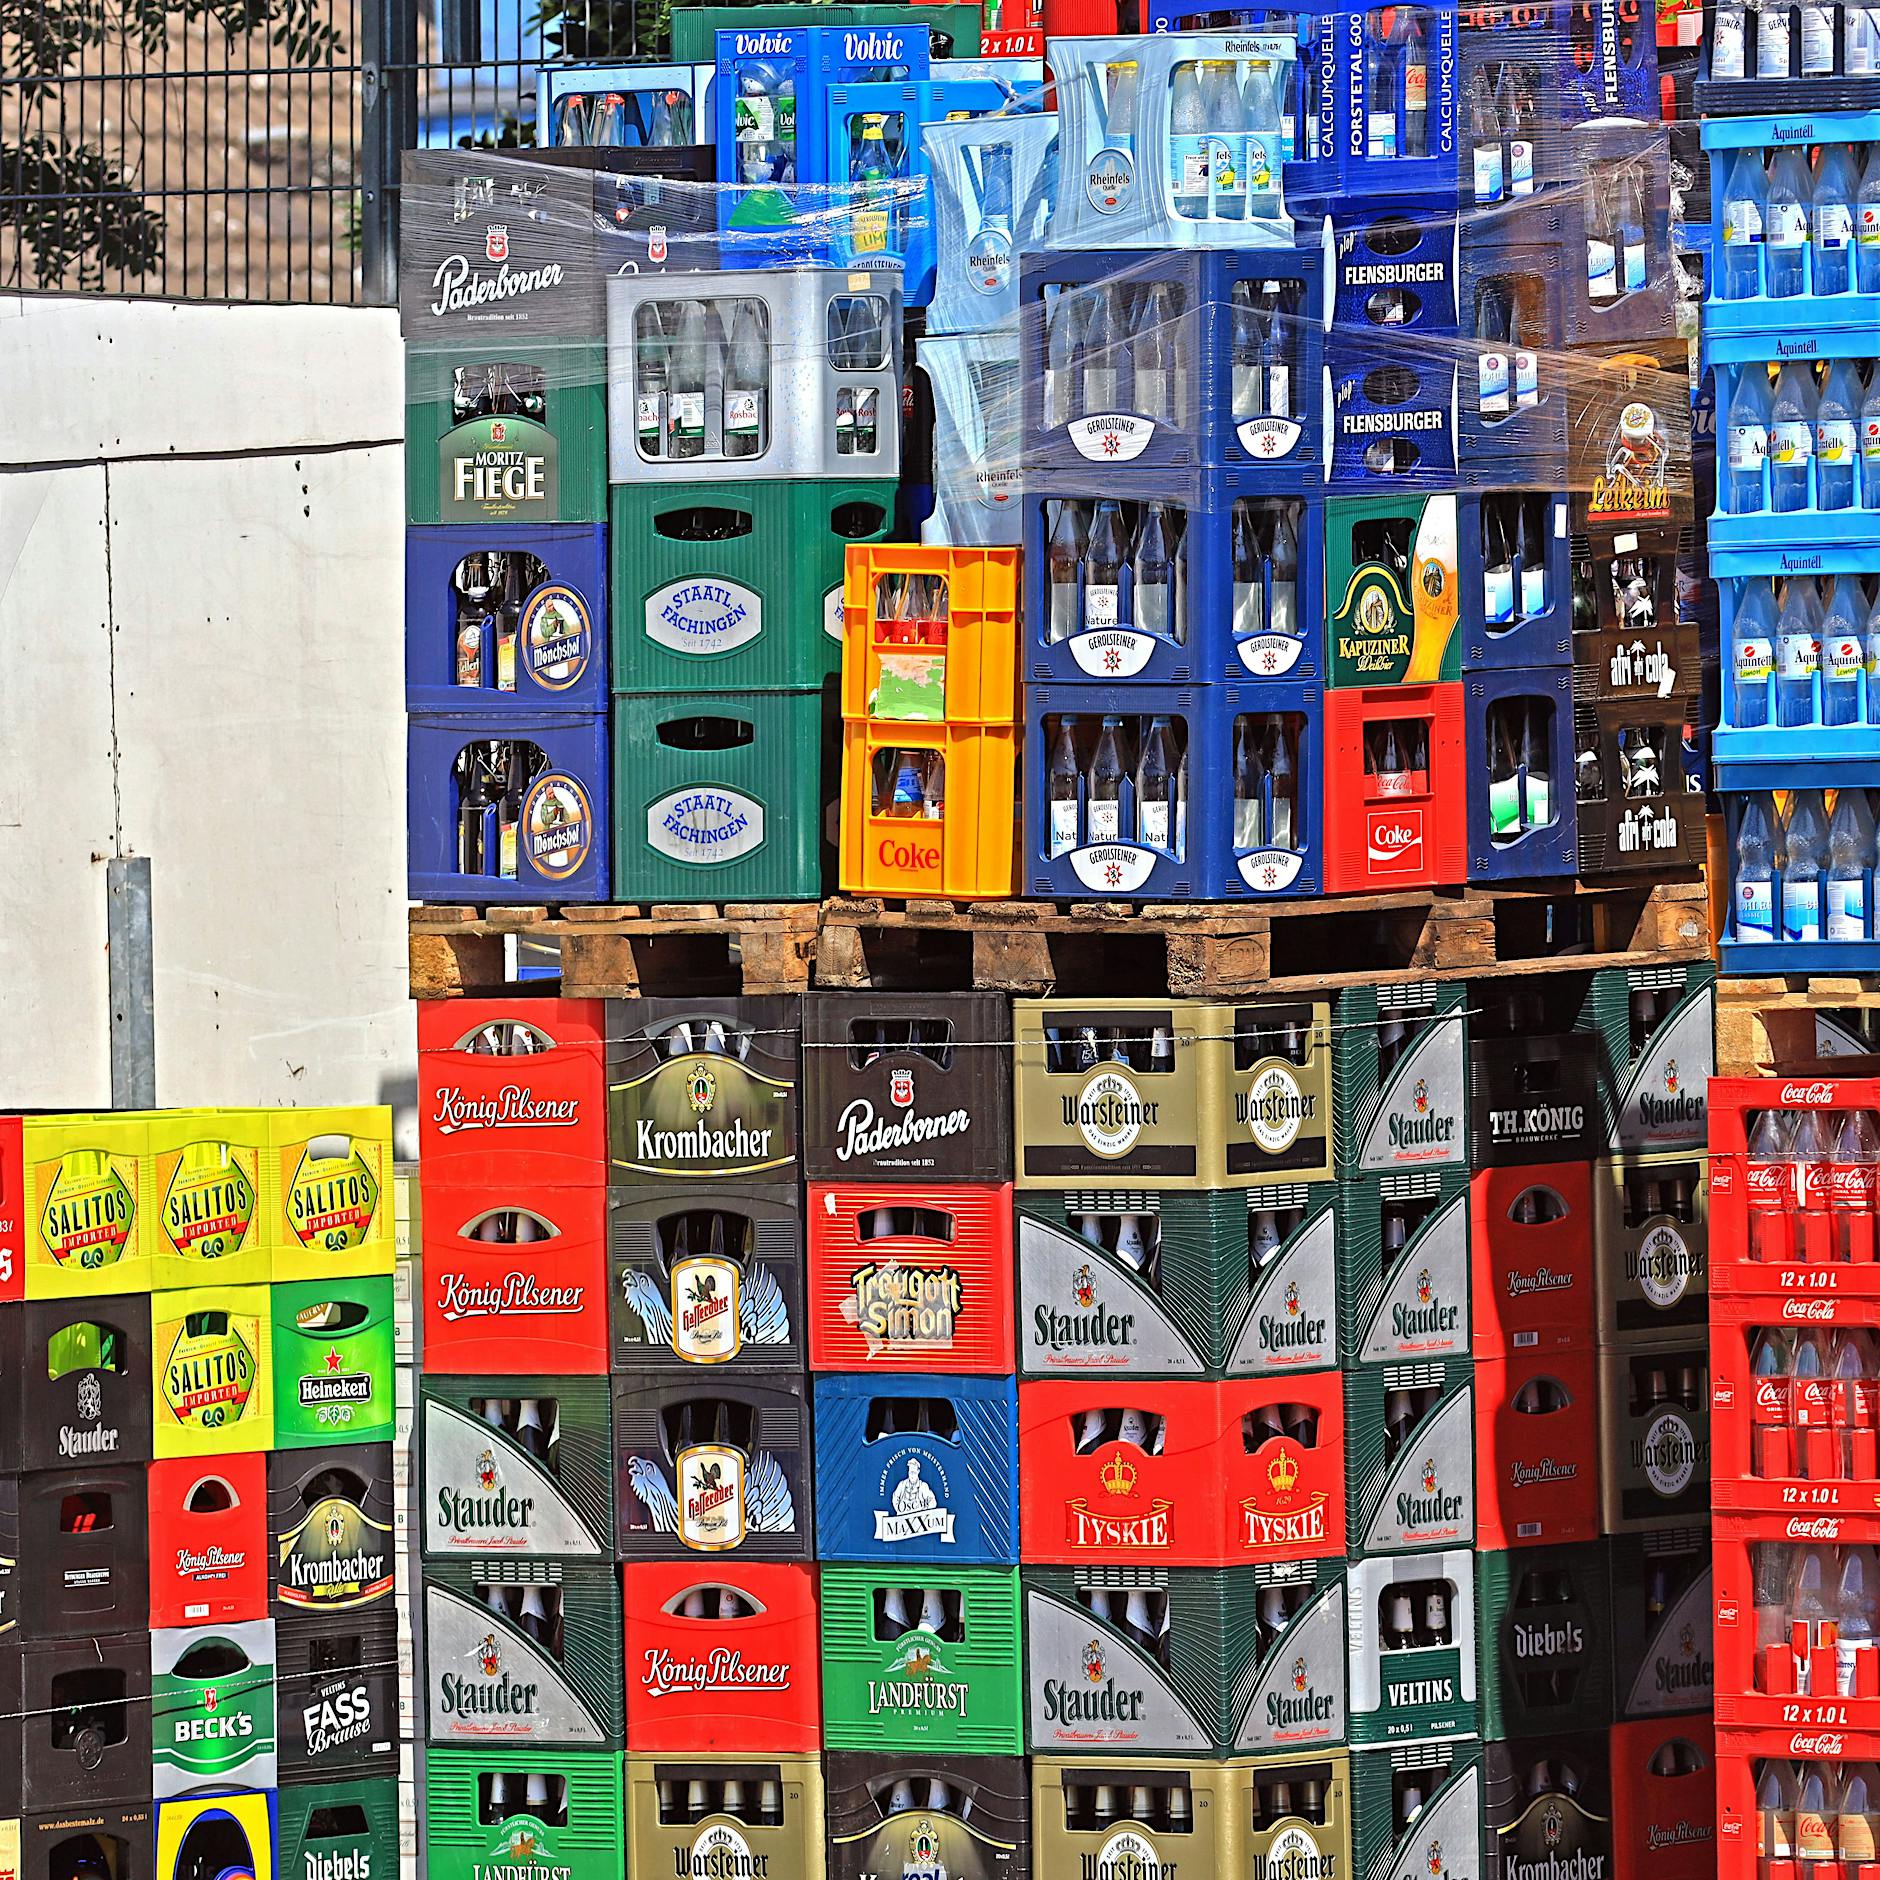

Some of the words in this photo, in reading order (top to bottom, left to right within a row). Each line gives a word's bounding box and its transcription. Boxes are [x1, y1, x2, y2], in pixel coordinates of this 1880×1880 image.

[735, 32, 792, 54] Volvic
[992, 41, 1000, 53] x
[1005, 37, 1023, 52] 1.0
[1027, 36, 1034, 52] L
[1350, 14, 1362, 46] 600
[844, 32, 903, 60] Volvic
[1225, 41, 1260, 52] Rheinfels
[1322, 15, 1335, 158] CALCIUMQUELLE
[1441, 11, 1453, 152] CALCIUMQUELLE
[1350, 49, 1363, 156] FORSTETAL
[1772, 124, 1814, 141] Aquintéll
[1090, 173, 1130, 185] Rheinfels
[970, 256, 1009, 267] Rheinfels
[1345, 263, 1444, 285] FLENSBURGER
[431, 255, 564, 316] Paderborner
[1776, 340, 1818, 357] Aquintéll
[1087, 417, 1135, 434] GEROLSTEINER
[1250, 420, 1289, 437] GEROLSTEINER
[1344, 411, 1442, 433] FLENSBURGER
[476, 452, 524, 466] MORITZ
[454, 456, 545, 501] FIEGE
[1588, 475, 1671, 513] Leikeim
[1780, 554, 1822, 572] Aquintéll
[673, 586, 733, 610] STAATL.
[661, 604, 747, 634] FACHINGEN
[533, 636, 580, 668] Mönchshof
[1088, 632, 1136, 650] GEROLSTEINER
[1250, 638, 1289, 653] GEROLSTEINER
[1339, 635, 1411, 659] KAPUZINER
[674, 795, 734, 820] STAATL.
[534, 824, 580, 854] Mönchshof
[663, 813, 748, 844] FACHINGEN
[1374, 825, 1412, 845] Coke
[1618, 809, 1640, 851] afri
[1654, 806, 1676, 849] cola
[879, 840, 940, 869] Coke
[1089, 848, 1137, 866] GEROLSTEINER
[1250, 854, 1289, 868] GEROLSTEINER
[433, 1088, 499, 1127] König
[496, 1084, 578, 1119] Pilsener
[1235, 1091, 1316, 1124] Warsteiner
[1781, 1083, 1833, 1104] Coca-Cola
[1061, 1094, 1158, 1127] Warsteiner
[1489, 1103, 1584, 1135] TH.KÖNIG
[636, 1118, 772, 1160] Krombacher
[836, 1099, 970, 1161] Paderborner
[1388, 1112, 1454, 1149] Stauder
[1515, 1134, 1558, 1142] BRAUWERKE
[170, 1185, 247, 1228] SALITOS
[294, 1176, 370, 1218] SALITOS
[49, 1189, 126, 1238] SALITOS
[183, 1217, 238, 1238] IMPORTED
[308, 1209, 361, 1229] IMPORTED
[63, 1226, 117, 1248] IMPORTED
[1625, 1248, 1703, 1281] Warsteiner
[1781, 1272, 1794, 1286] 12
[1797, 1275, 1804, 1286] x
[1809, 1272, 1827, 1287] 1.0
[1830, 1273, 1837, 1287] L
[438, 1274, 504, 1313] König
[502, 1271, 584, 1306] Pilsener
[852, 1264, 962, 1313] Traugott
[1506, 1271, 1537, 1294] König
[1535, 1268, 1573, 1289] Pilsener
[860, 1302, 953, 1338] Simon
[1392, 1298, 1458, 1339] Stauder
[1783, 1298, 1835, 1320] Coca-Cola
[1034, 1303, 1135, 1351] Stauder
[1259, 1311, 1325, 1352] Stauder
[171, 1351, 247, 1396] SALITOS
[302, 1378, 367, 1399] Heineken
[183, 1385, 238, 1407] IMPORTED
[58, 1422, 119, 1457] Stauder
[1510, 1461, 1541, 1486] König
[1539, 1458, 1577, 1481] Pilsener
[438, 1486, 533, 1532] Stauder
[1396, 1492, 1463, 1529] Stauder
[1783, 1488, 1797, 1502] 12
[1799, 1491, 1807, 1502] x
[1812, 1488, 1830, 1503] 1.0
[1832, 1489, 1838, 1503] L
[1073, 1512, 1168, 1545] TYSKIE
[1245, 1505, 1324, 1545] TYSKIE
[1786, 1517, 1839, 1539] Coca-Cola
[175, 1549, 208, 1571] König
[205, 1546, 245, 1568] Pilsener
[290, 1553, 383, 1587] Krombacher
[1514, 1621, 1583, 1659] Diebels
[641, 1649, 710, 1690] König
[701, 1647, 790, 1684] Pilsener
[321, 1681, 346, 1697] VELTINS
[441, 1672, 537, 1717] Stauder
[868, 1677, 968, 1718] LANDFÜRST
[1043, 1678, 1144, 1726] Stauder
[1388, 1678, 1454, 1707] VELTINS
[302, 1686, 371, 1736] FASS
[1267, 1687, 1334, 1728] Stauder
[174, 1712, 252, 1742] BECK'S
[307, 1718, 371, 1756] Brause
[1388, 1726, 1395, 1734] 20
[1401, 1725, 1409, 1734] 0,5
[1431, 1721, 1456, 1729] PILSENER
[1790, 1733, 1843, 1755] Coca-Cola
[673, 1845, 769, 1879] Warsteiner
[1080, 1852, 1177, 1880] Warsteiner
[1254, 1853, 1335, 1880] Warsteiner
[1506, 1848, 1604, 1880] Krombacher
